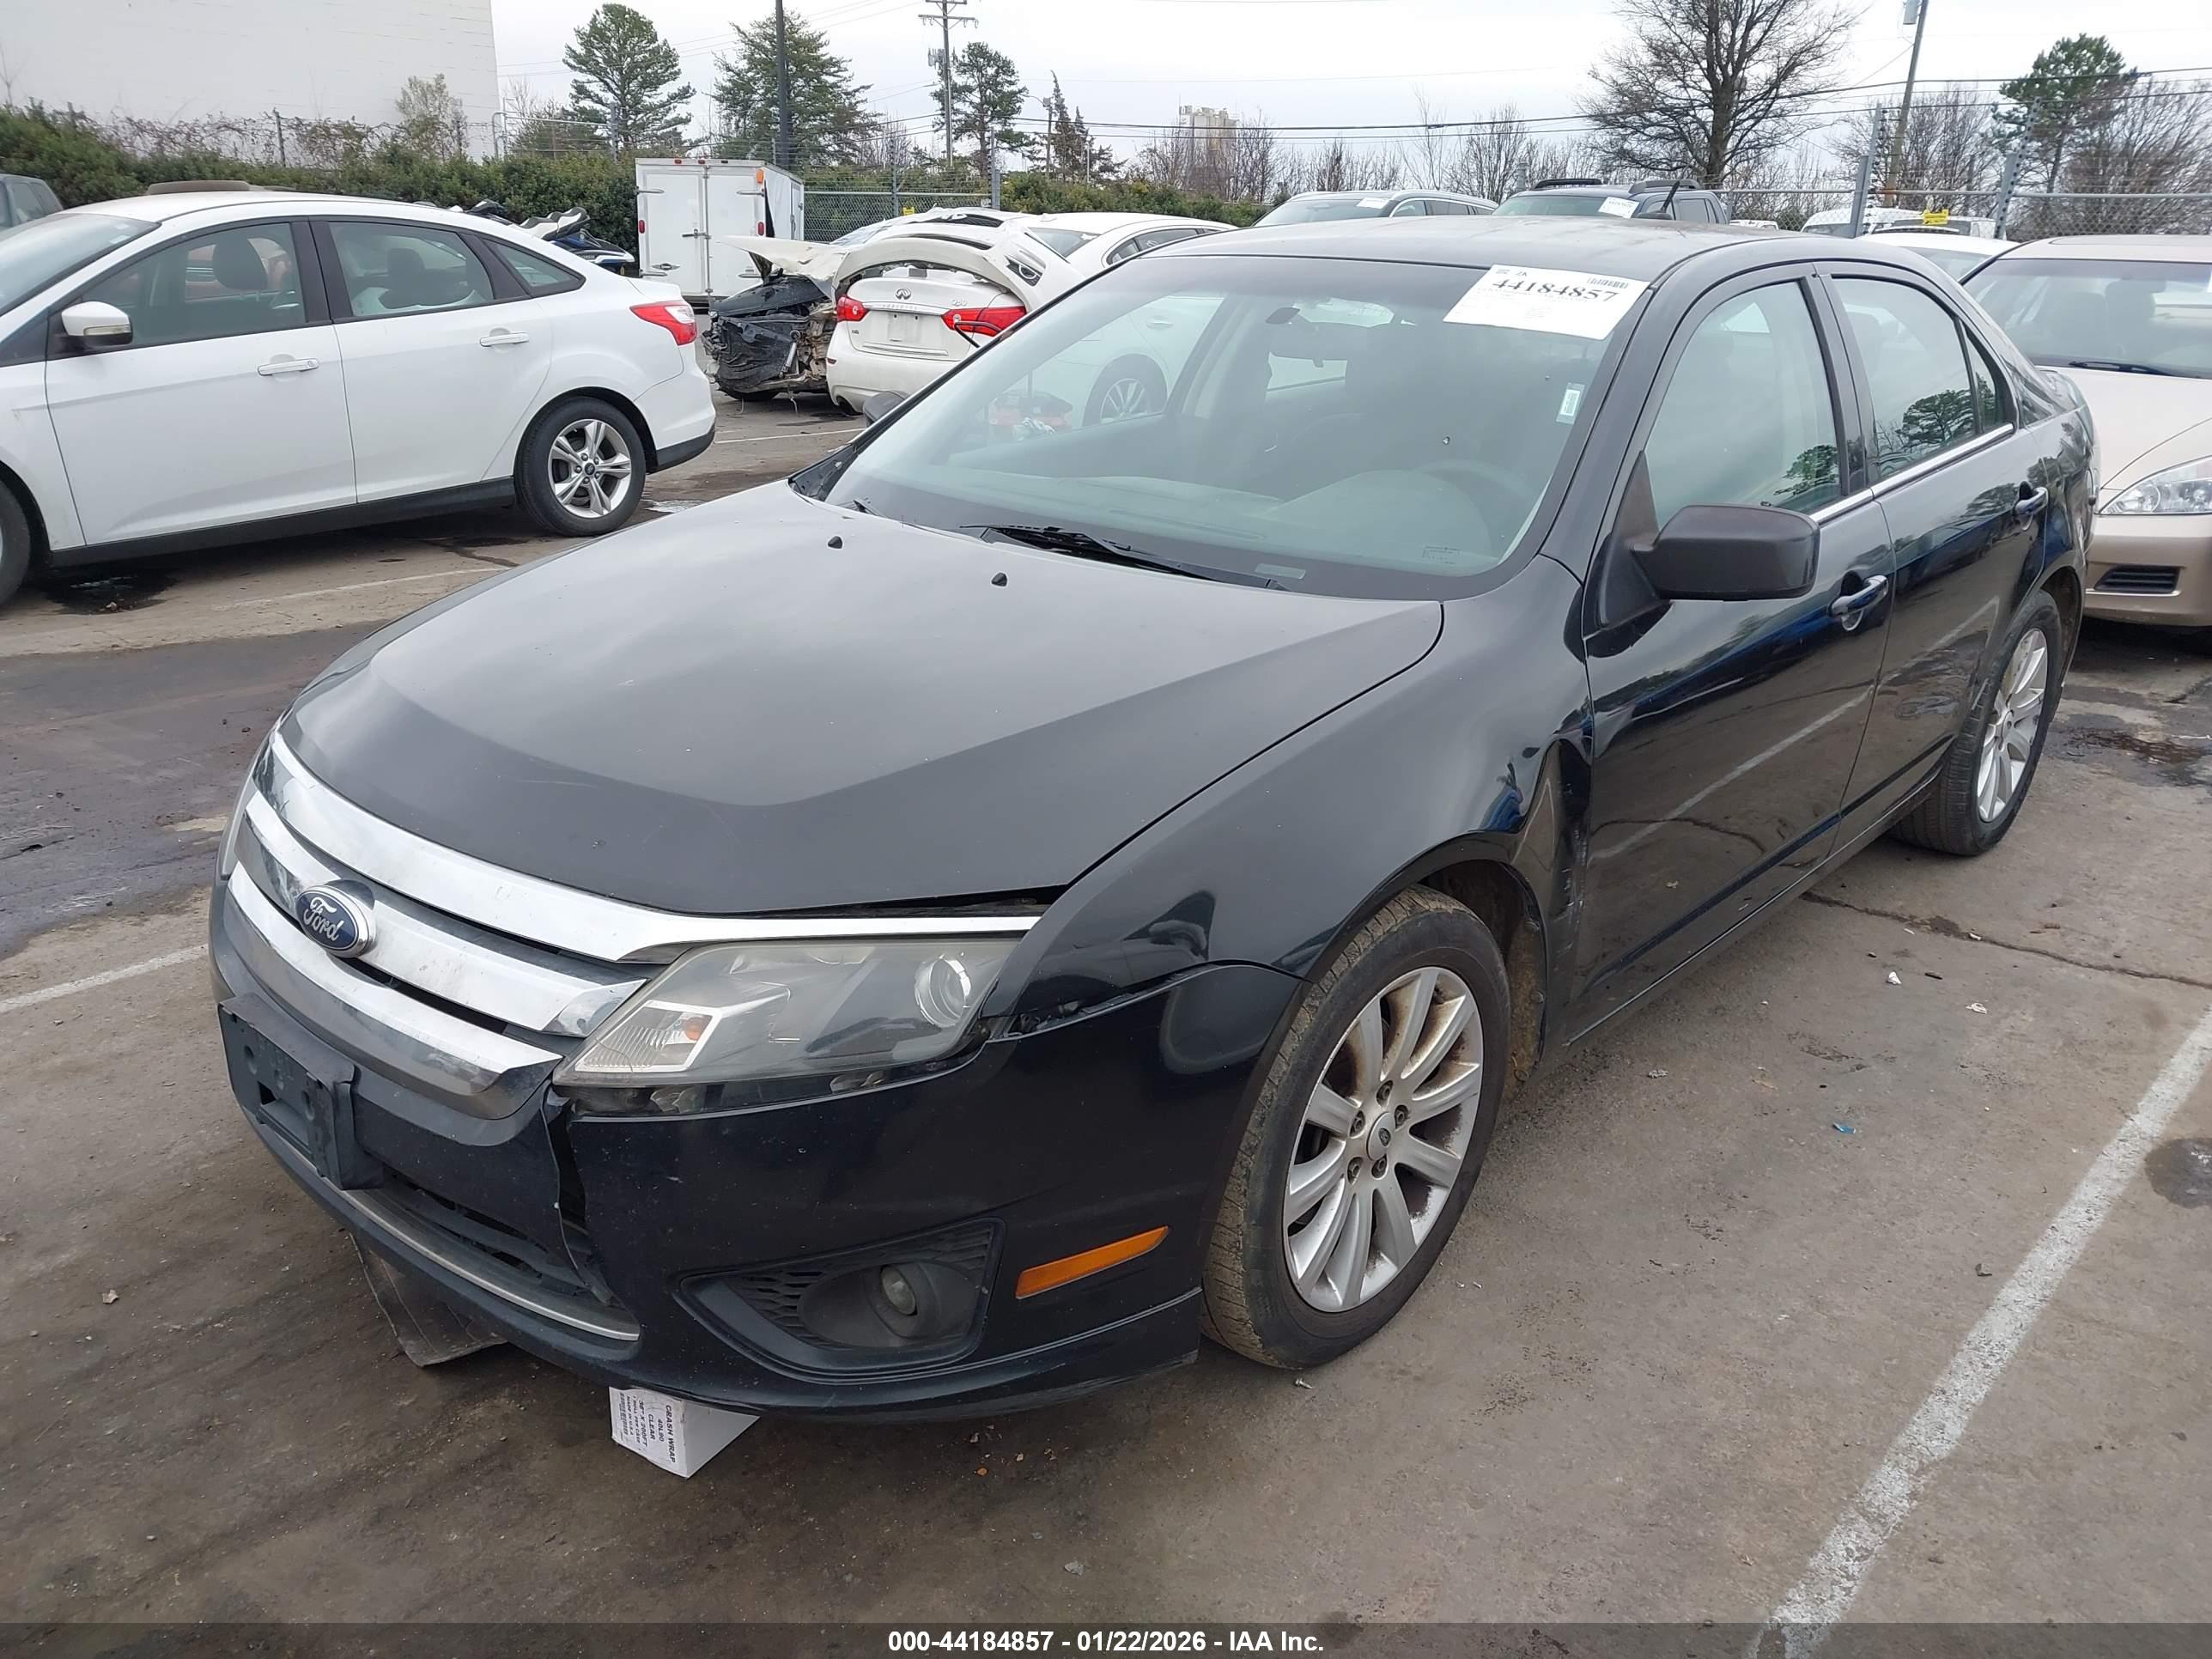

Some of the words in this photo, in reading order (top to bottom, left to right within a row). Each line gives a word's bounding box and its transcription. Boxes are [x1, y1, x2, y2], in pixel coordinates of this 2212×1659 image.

[1492, 279, 1619, 301] 44184857
[303, 896, 344, 941] Ford
[665, 1404, 674, 1437] CRASH
